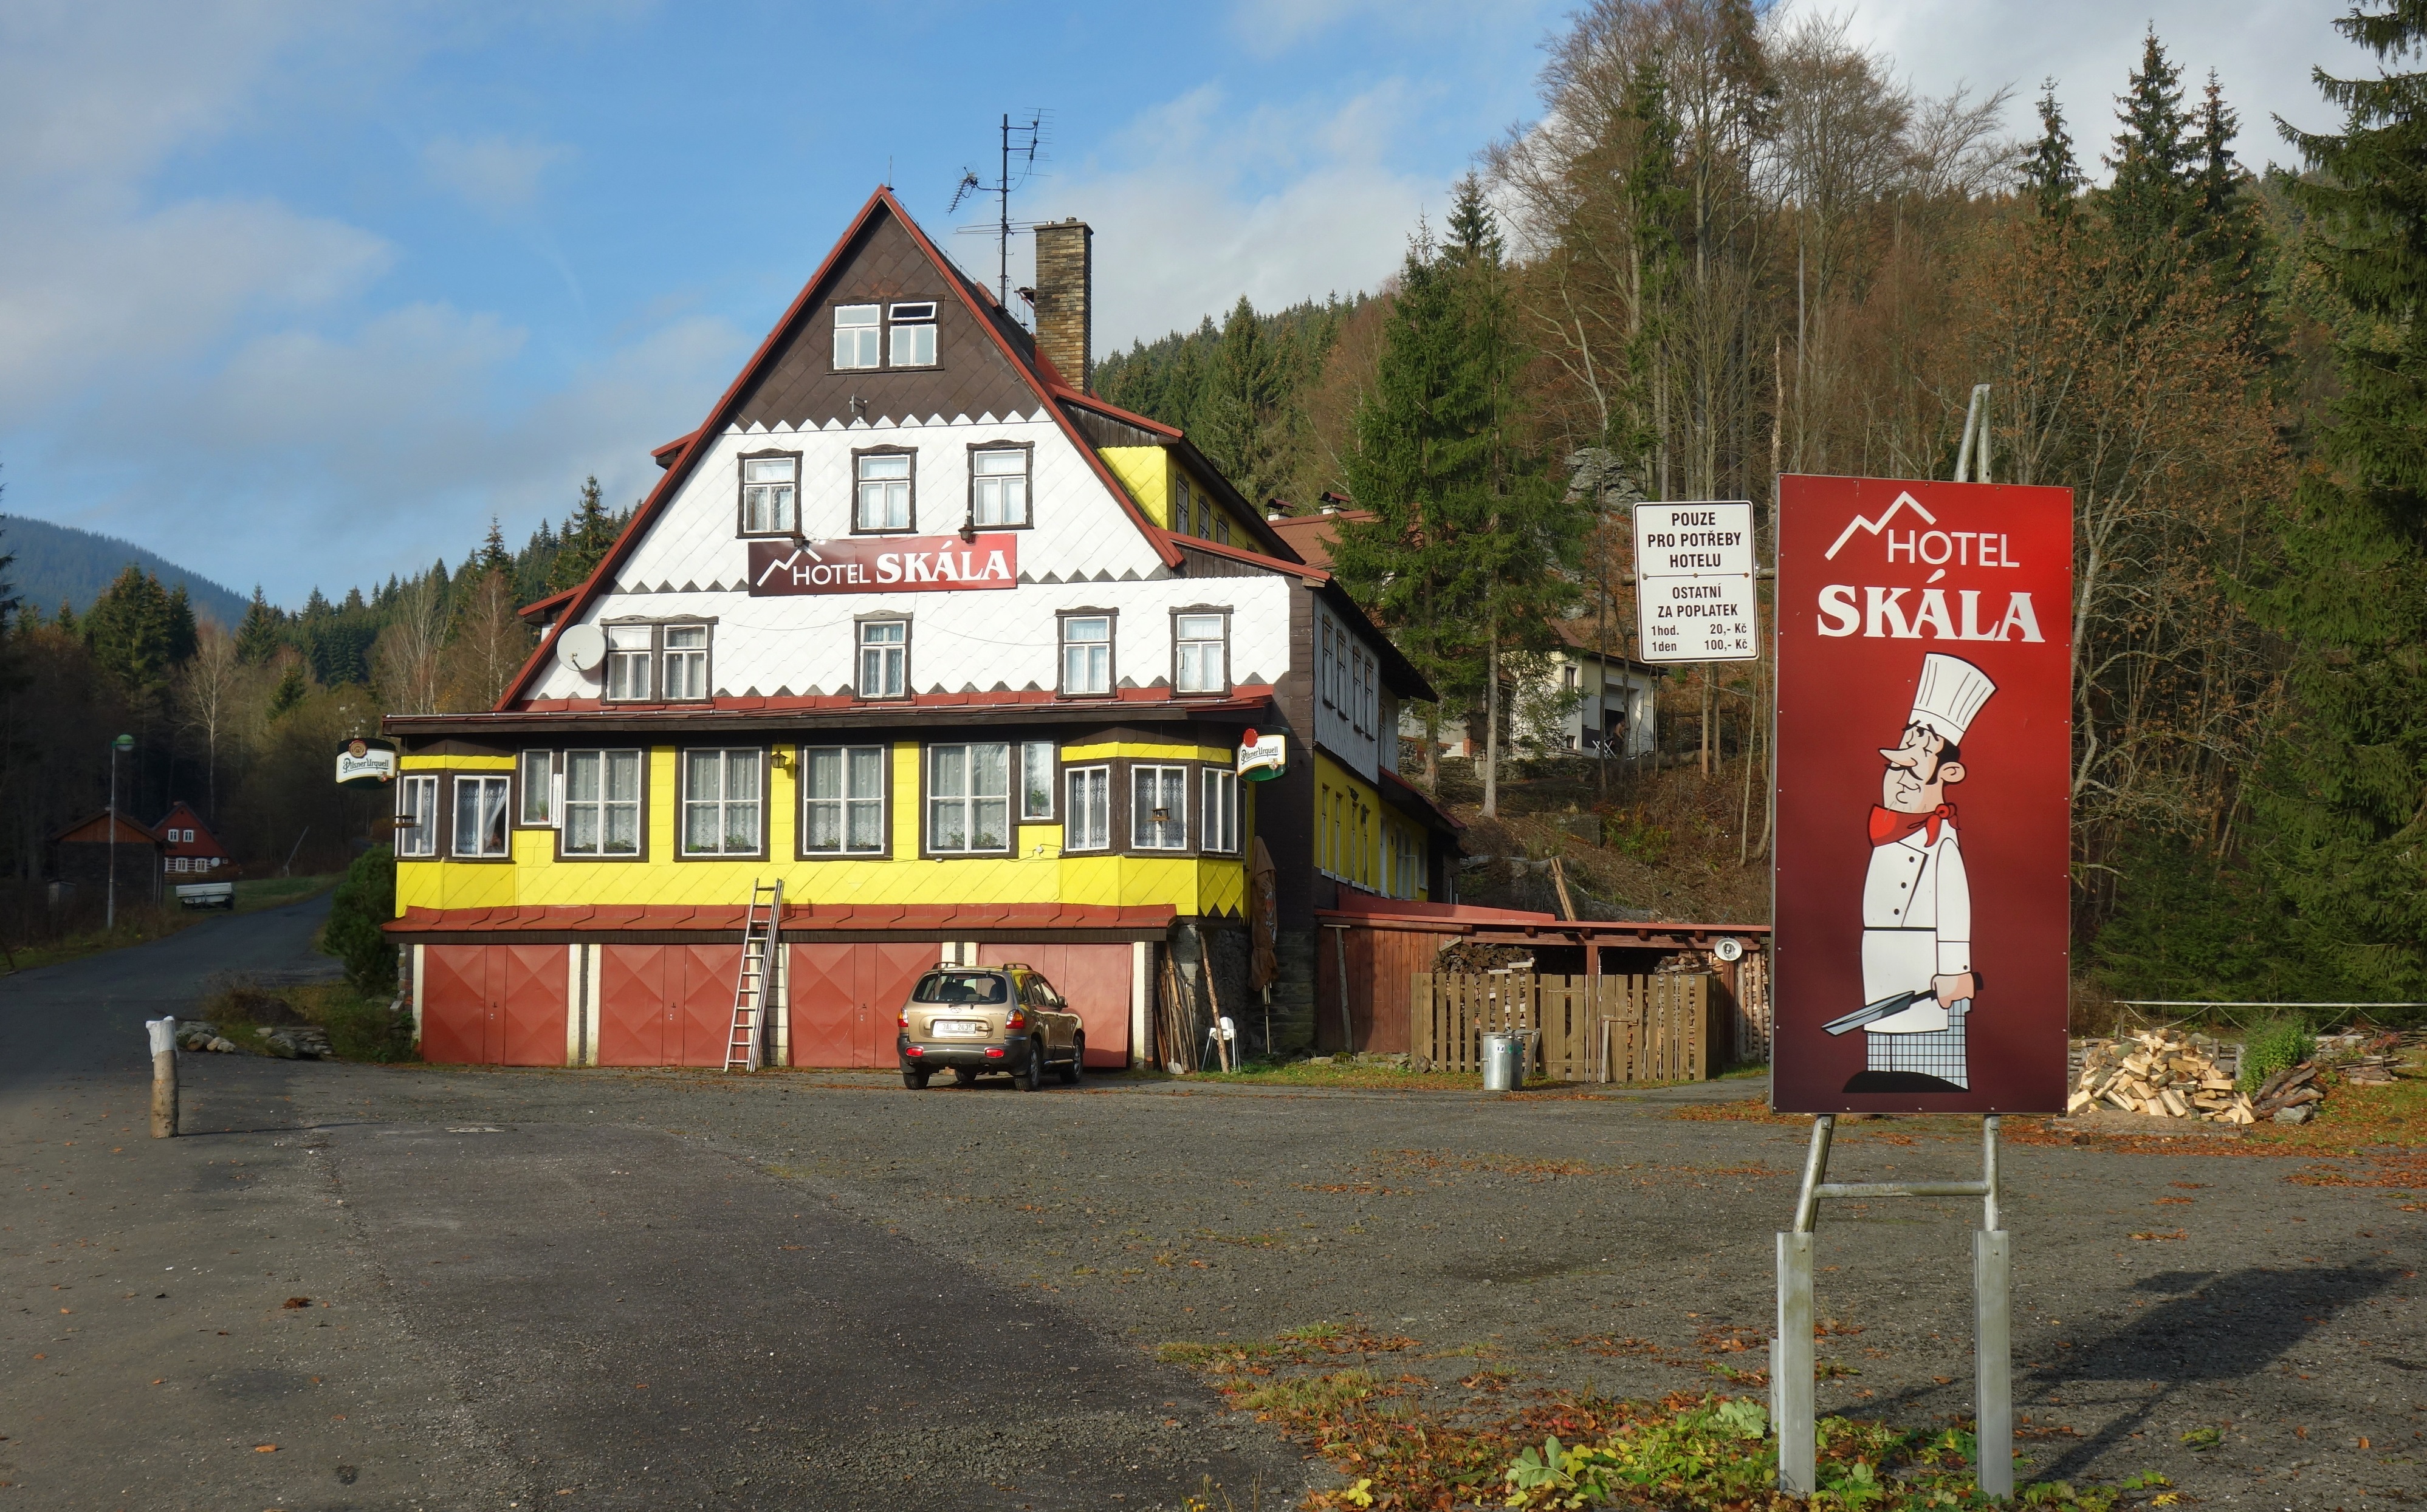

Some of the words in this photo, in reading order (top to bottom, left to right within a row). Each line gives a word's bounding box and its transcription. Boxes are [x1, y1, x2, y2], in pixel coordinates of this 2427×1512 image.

[1672, 512, 1716, 526] POUZE
[1647, 533, 1675, 547] PRO
[1681, 530, 1742, 547] POTŘEBY
[1887, 529, 2020, 567] HOTEL
[793, 564, 871, 586] HOTEL
[876, 540, 1012, 584] SKÁLA
[1670, 553, 1721, 568] HOTELU
[1672, 583, 1722, 599] OSTATNÍ
[1658, 606, 1673, 618] ZA
[1677, 604, 1738, 617] POPLATEK
[1817, 569, 2046, 643] SKÁLA
[1651, 624, 1680, 636] 1hod.
[1710, 624, 1731, 635] 20,-
[1734, 623, 1747, 634] Kč
[1652, 641, 1677, 652] 1den
[1704, 639, 1732, 651] 100,-
[1735, 638, 1748, 649] Kč
[1241, 749, 1258, 765] Pilsner
[1258, 746, 1279, 757] Urquell
[343, 758, 367, 773] Pilsner
[366, 758, 389, 770] Urquell
